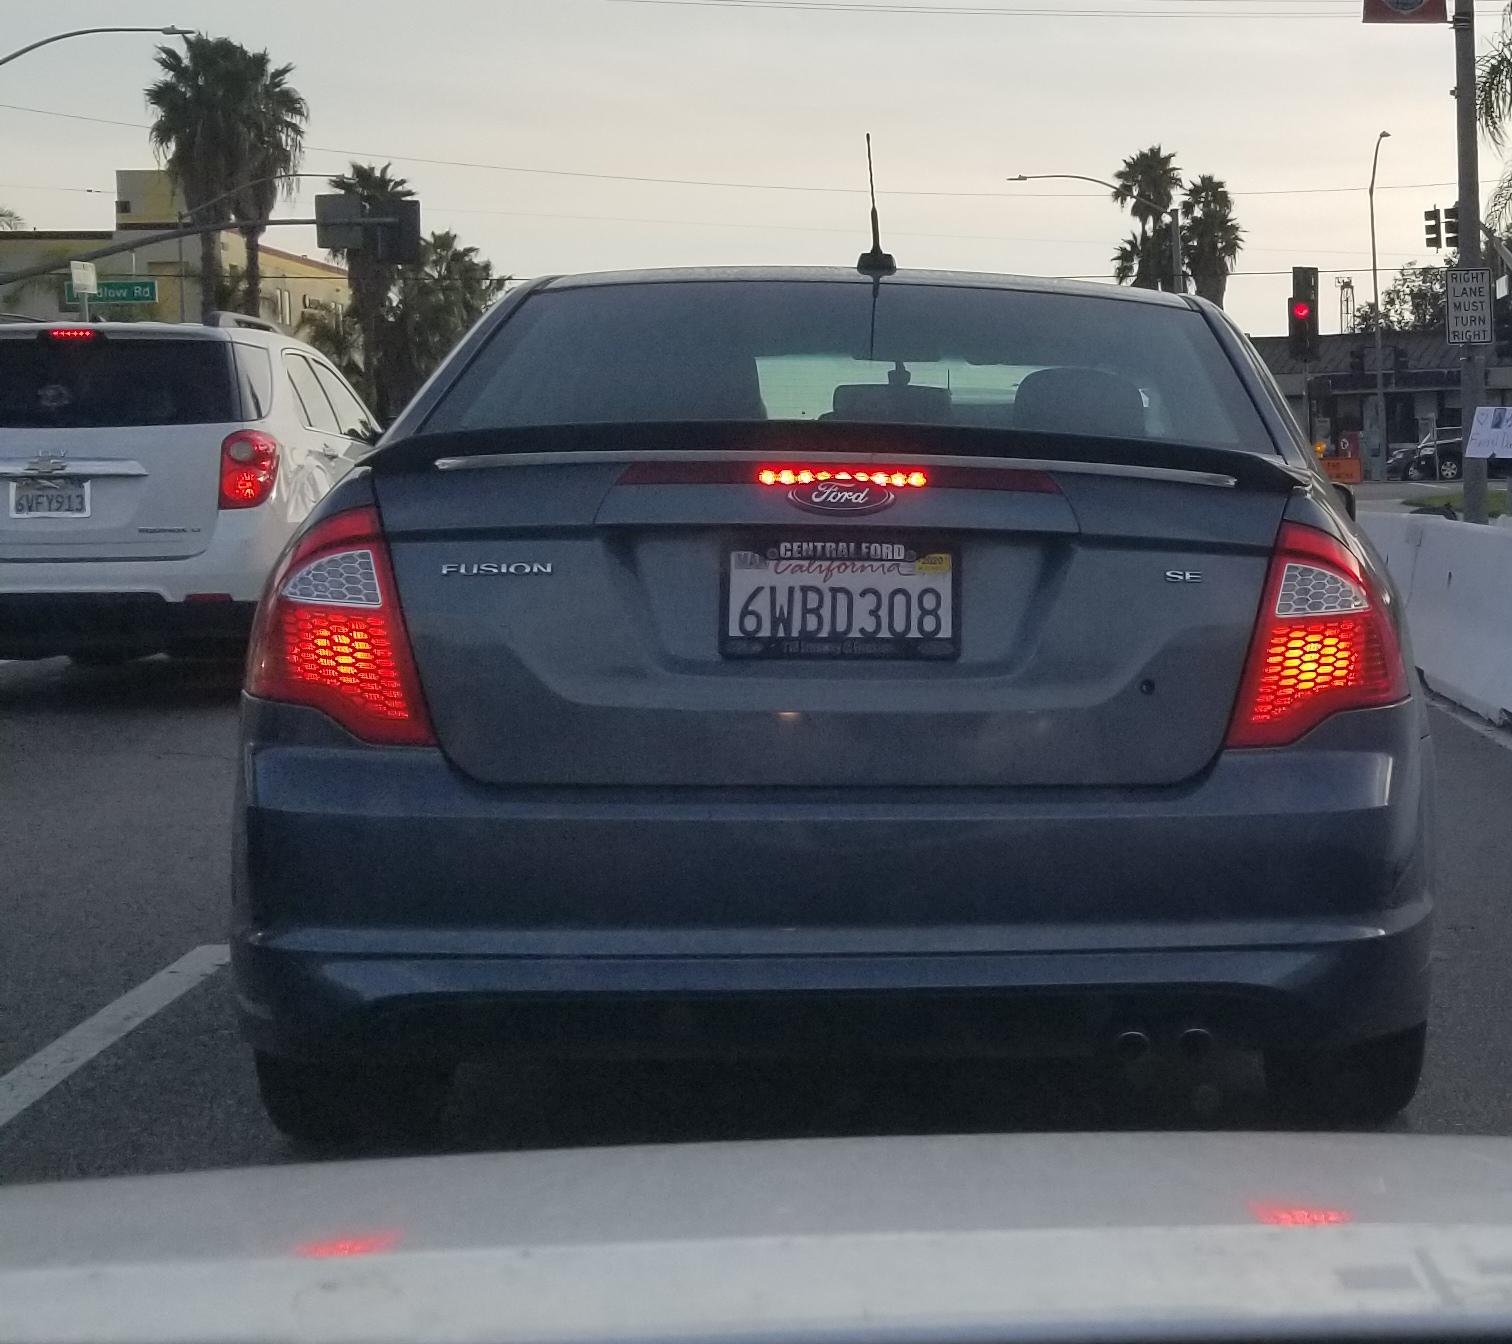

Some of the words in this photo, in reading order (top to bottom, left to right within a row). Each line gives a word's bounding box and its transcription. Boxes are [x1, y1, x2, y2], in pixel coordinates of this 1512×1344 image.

[1450, 271, 1486, 284] RIGHT
[133, 285, 150, 298] Rd
[1453, 286, 1486, 298] LANE
[1453, 301, 1486, 312] MUST
[1454, 316, 1487, 327] TURN
[1451, 329, 1489, 341] RIGHT
[811, 482, 870, 504] Ford
[15, 493, 85, 513] 6VFY913
[779, 542, 856, 560] CENTRAL
[860, 543, 906, 561] FORD
[441, 562, 553, 575] FUSION
[773, 560, 906, 583] California
[1165, 569, 1203, 582] SE
[738, 585, 943, 639] 6WBD308
